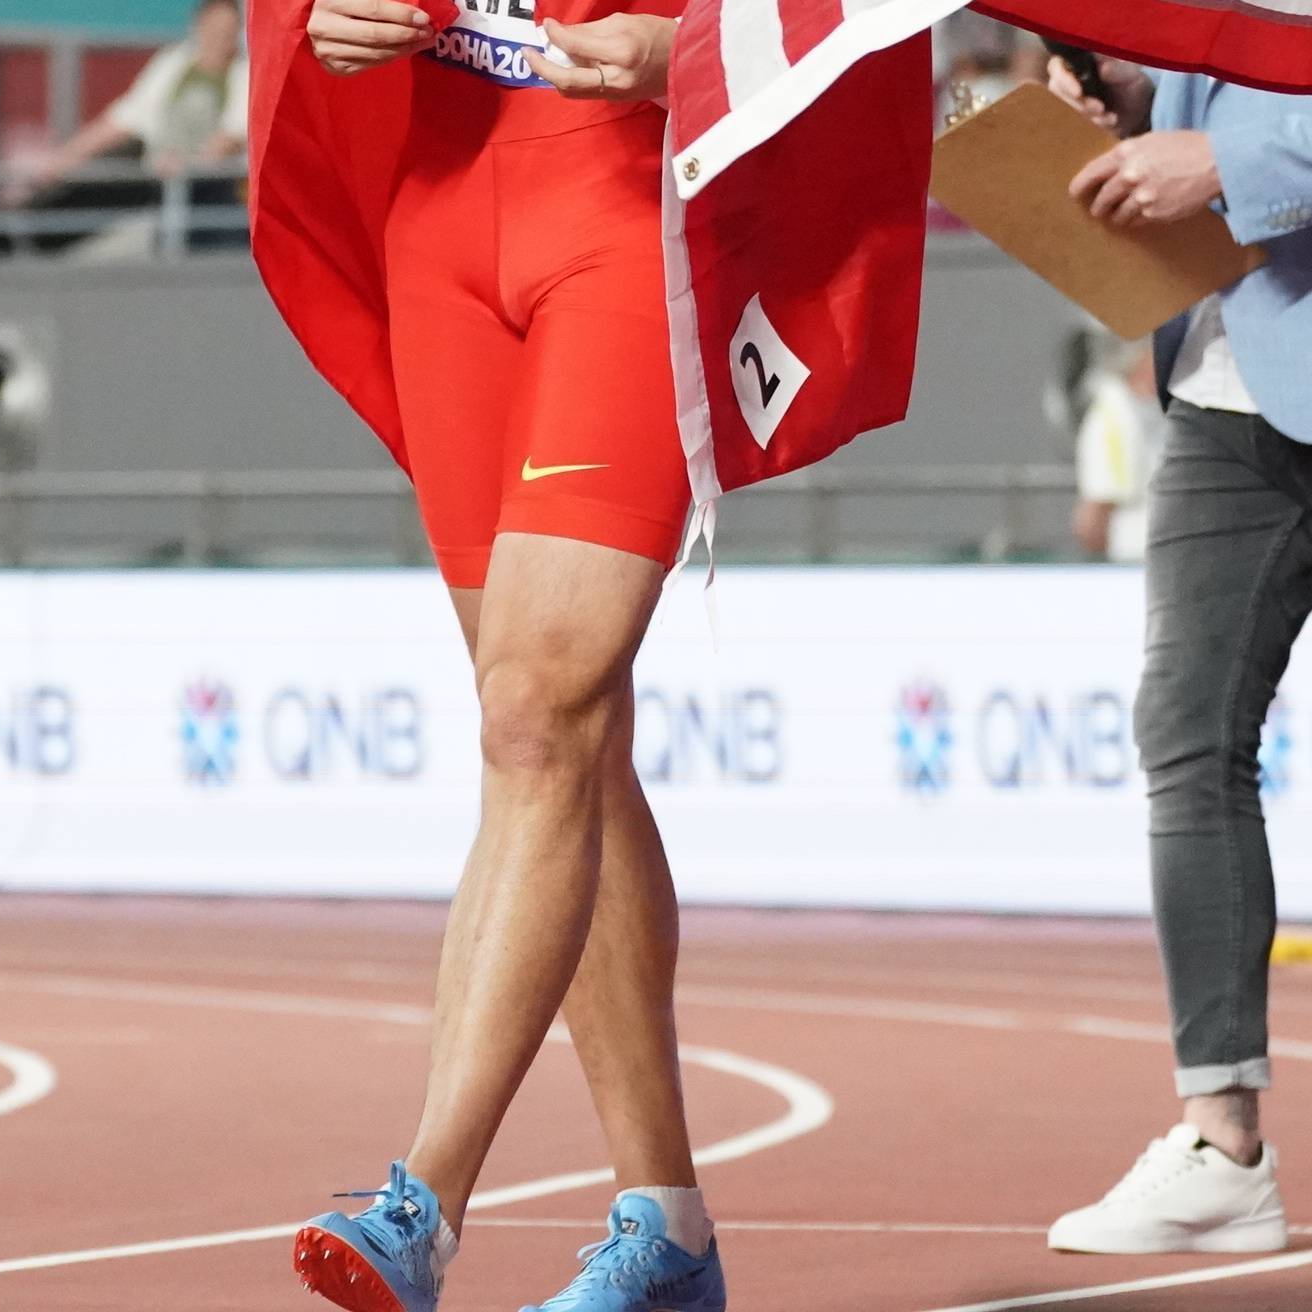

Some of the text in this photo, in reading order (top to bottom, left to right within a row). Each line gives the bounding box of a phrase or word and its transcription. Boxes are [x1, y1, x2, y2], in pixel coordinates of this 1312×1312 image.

[740, 341, 781, 410] 2
[264, 685, 426, 780] QNB
[633, 687, 784, 789] QNB
[977, 688, 1132, 791] QNB
